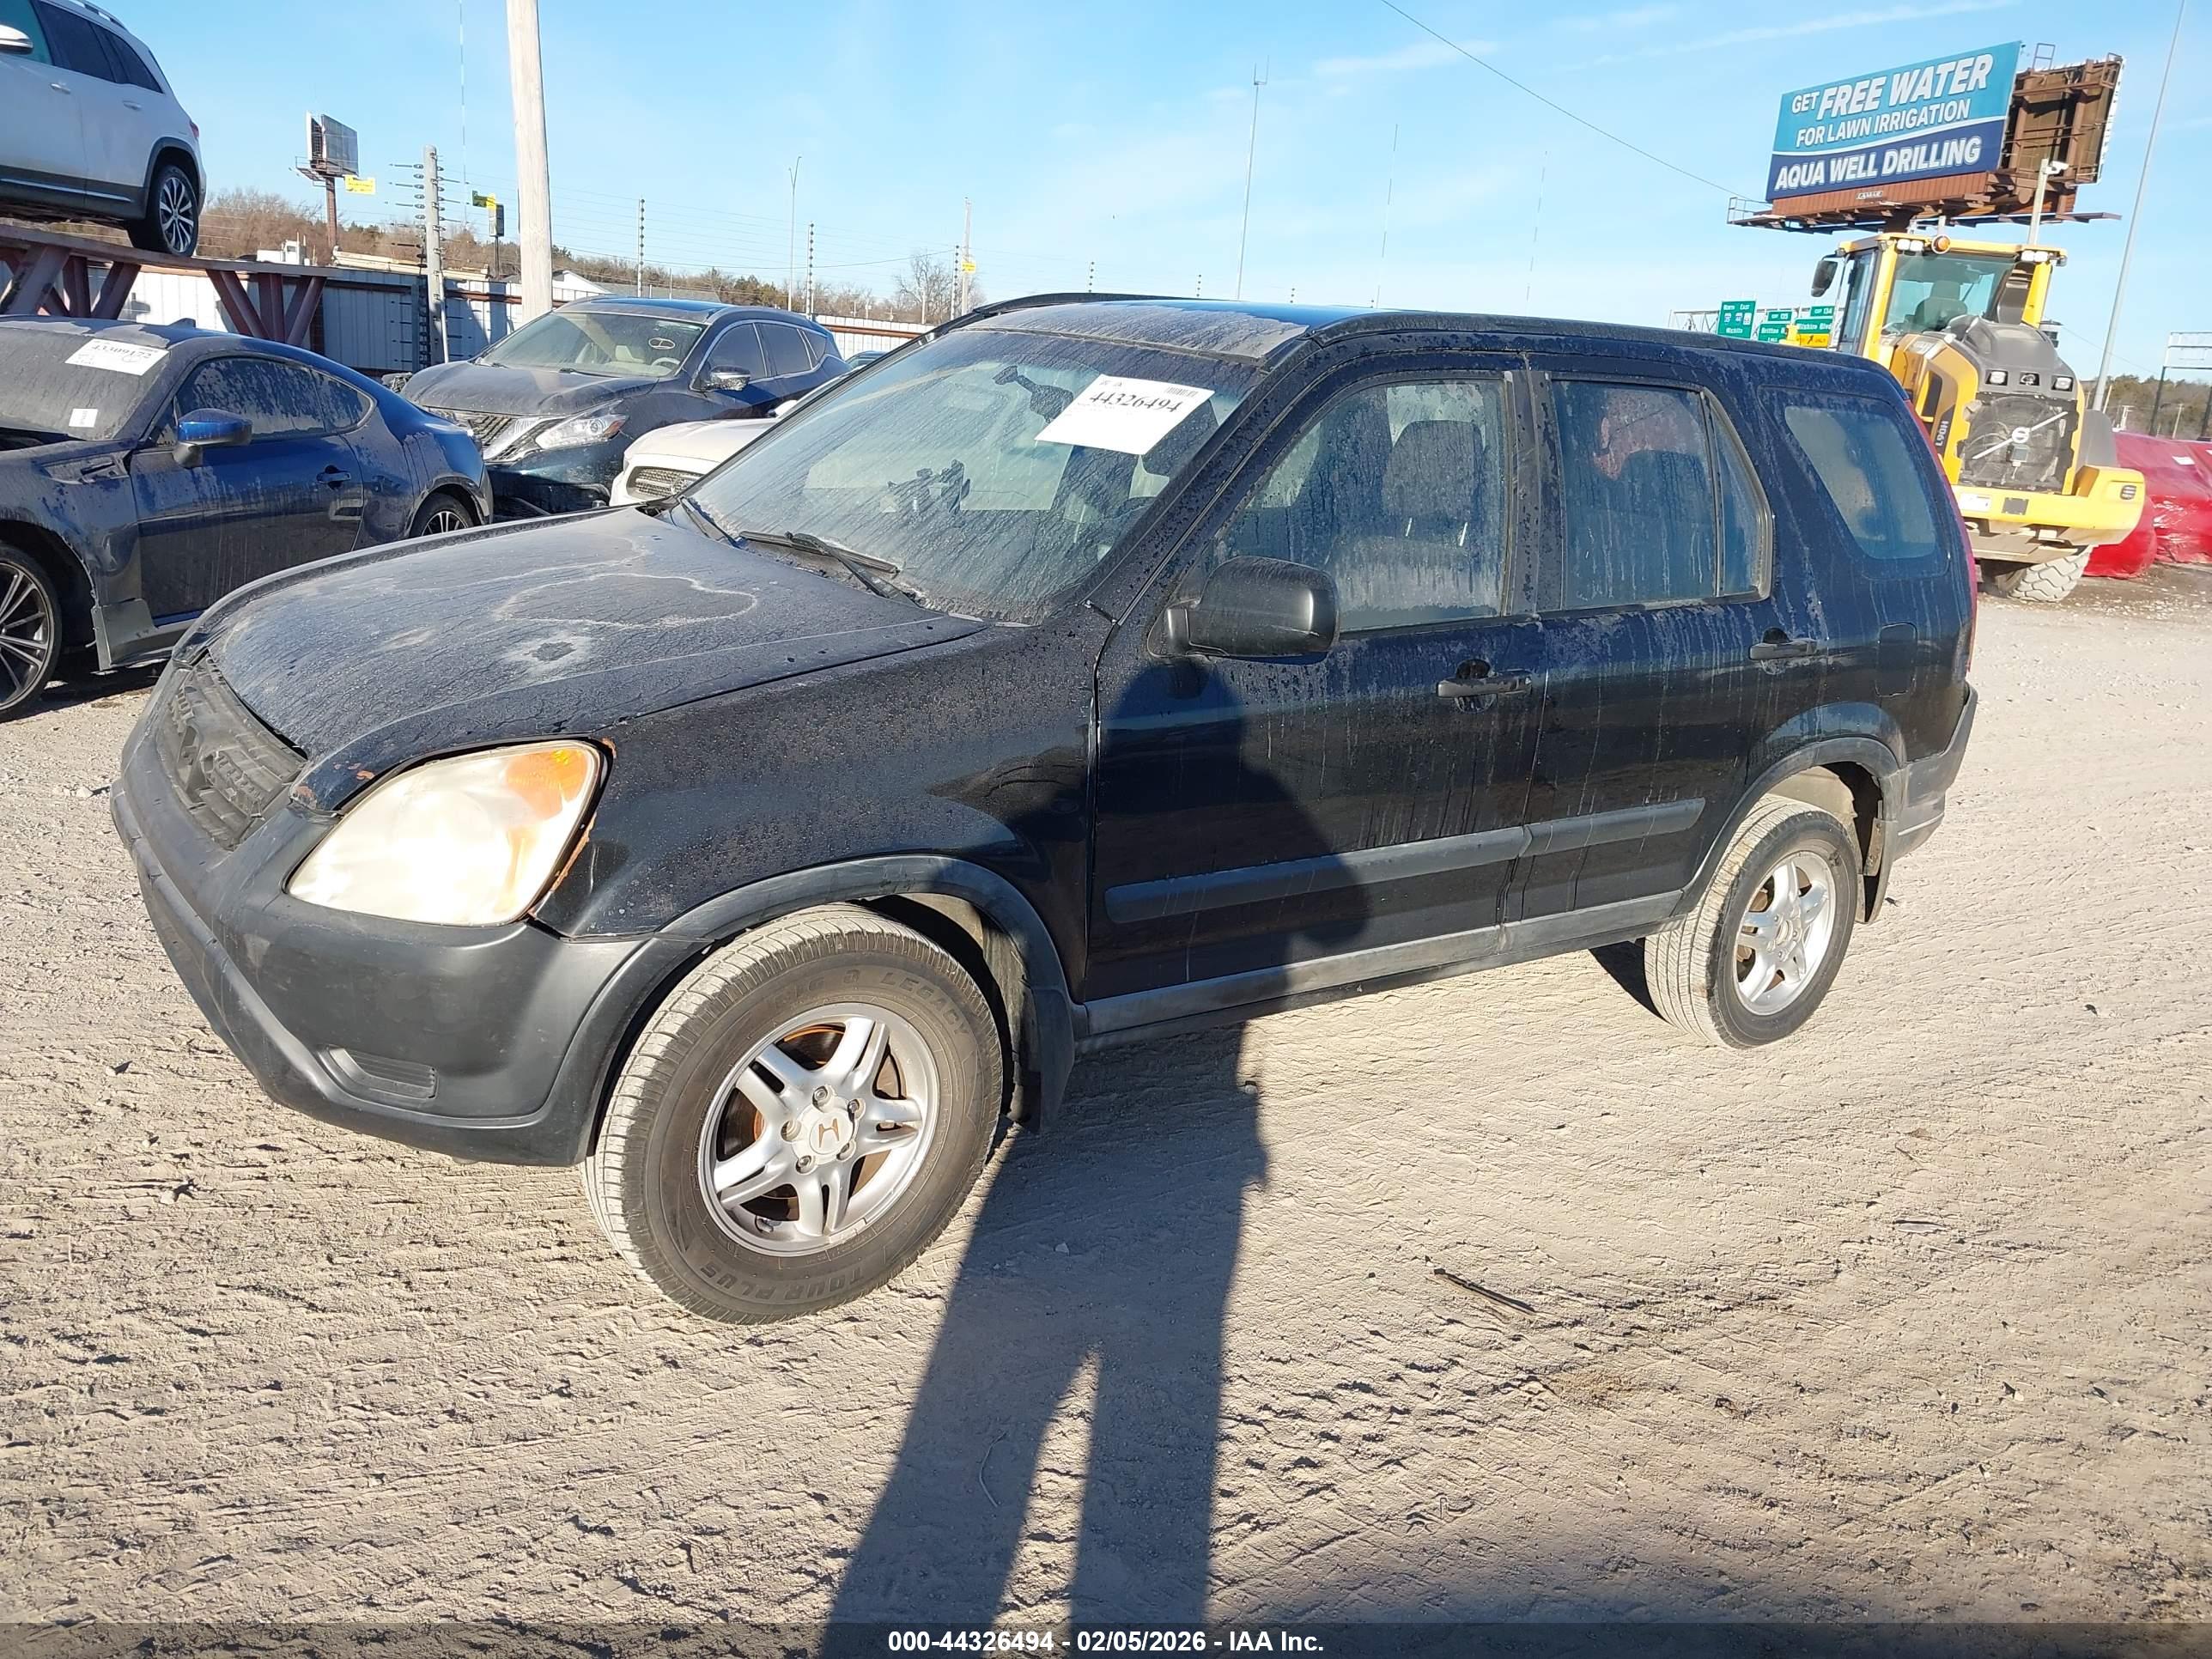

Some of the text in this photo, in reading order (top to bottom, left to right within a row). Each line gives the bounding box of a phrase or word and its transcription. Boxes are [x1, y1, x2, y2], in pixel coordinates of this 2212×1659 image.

[1792, 52, 1994, 120] GET FREE WATER
[1796, 98, 1972, 148] FOR LAWN IRRIGATION
[1774, 136, 1982, 191] AQUA WELL DRILLING
[1089, 391, 1184, 413] 44326494
[1936, 420, 1949, 446] L90H
[880, 971, 969, 1037] LEGACY
[700, 1261, 864, 1300] TOUR PLUS
